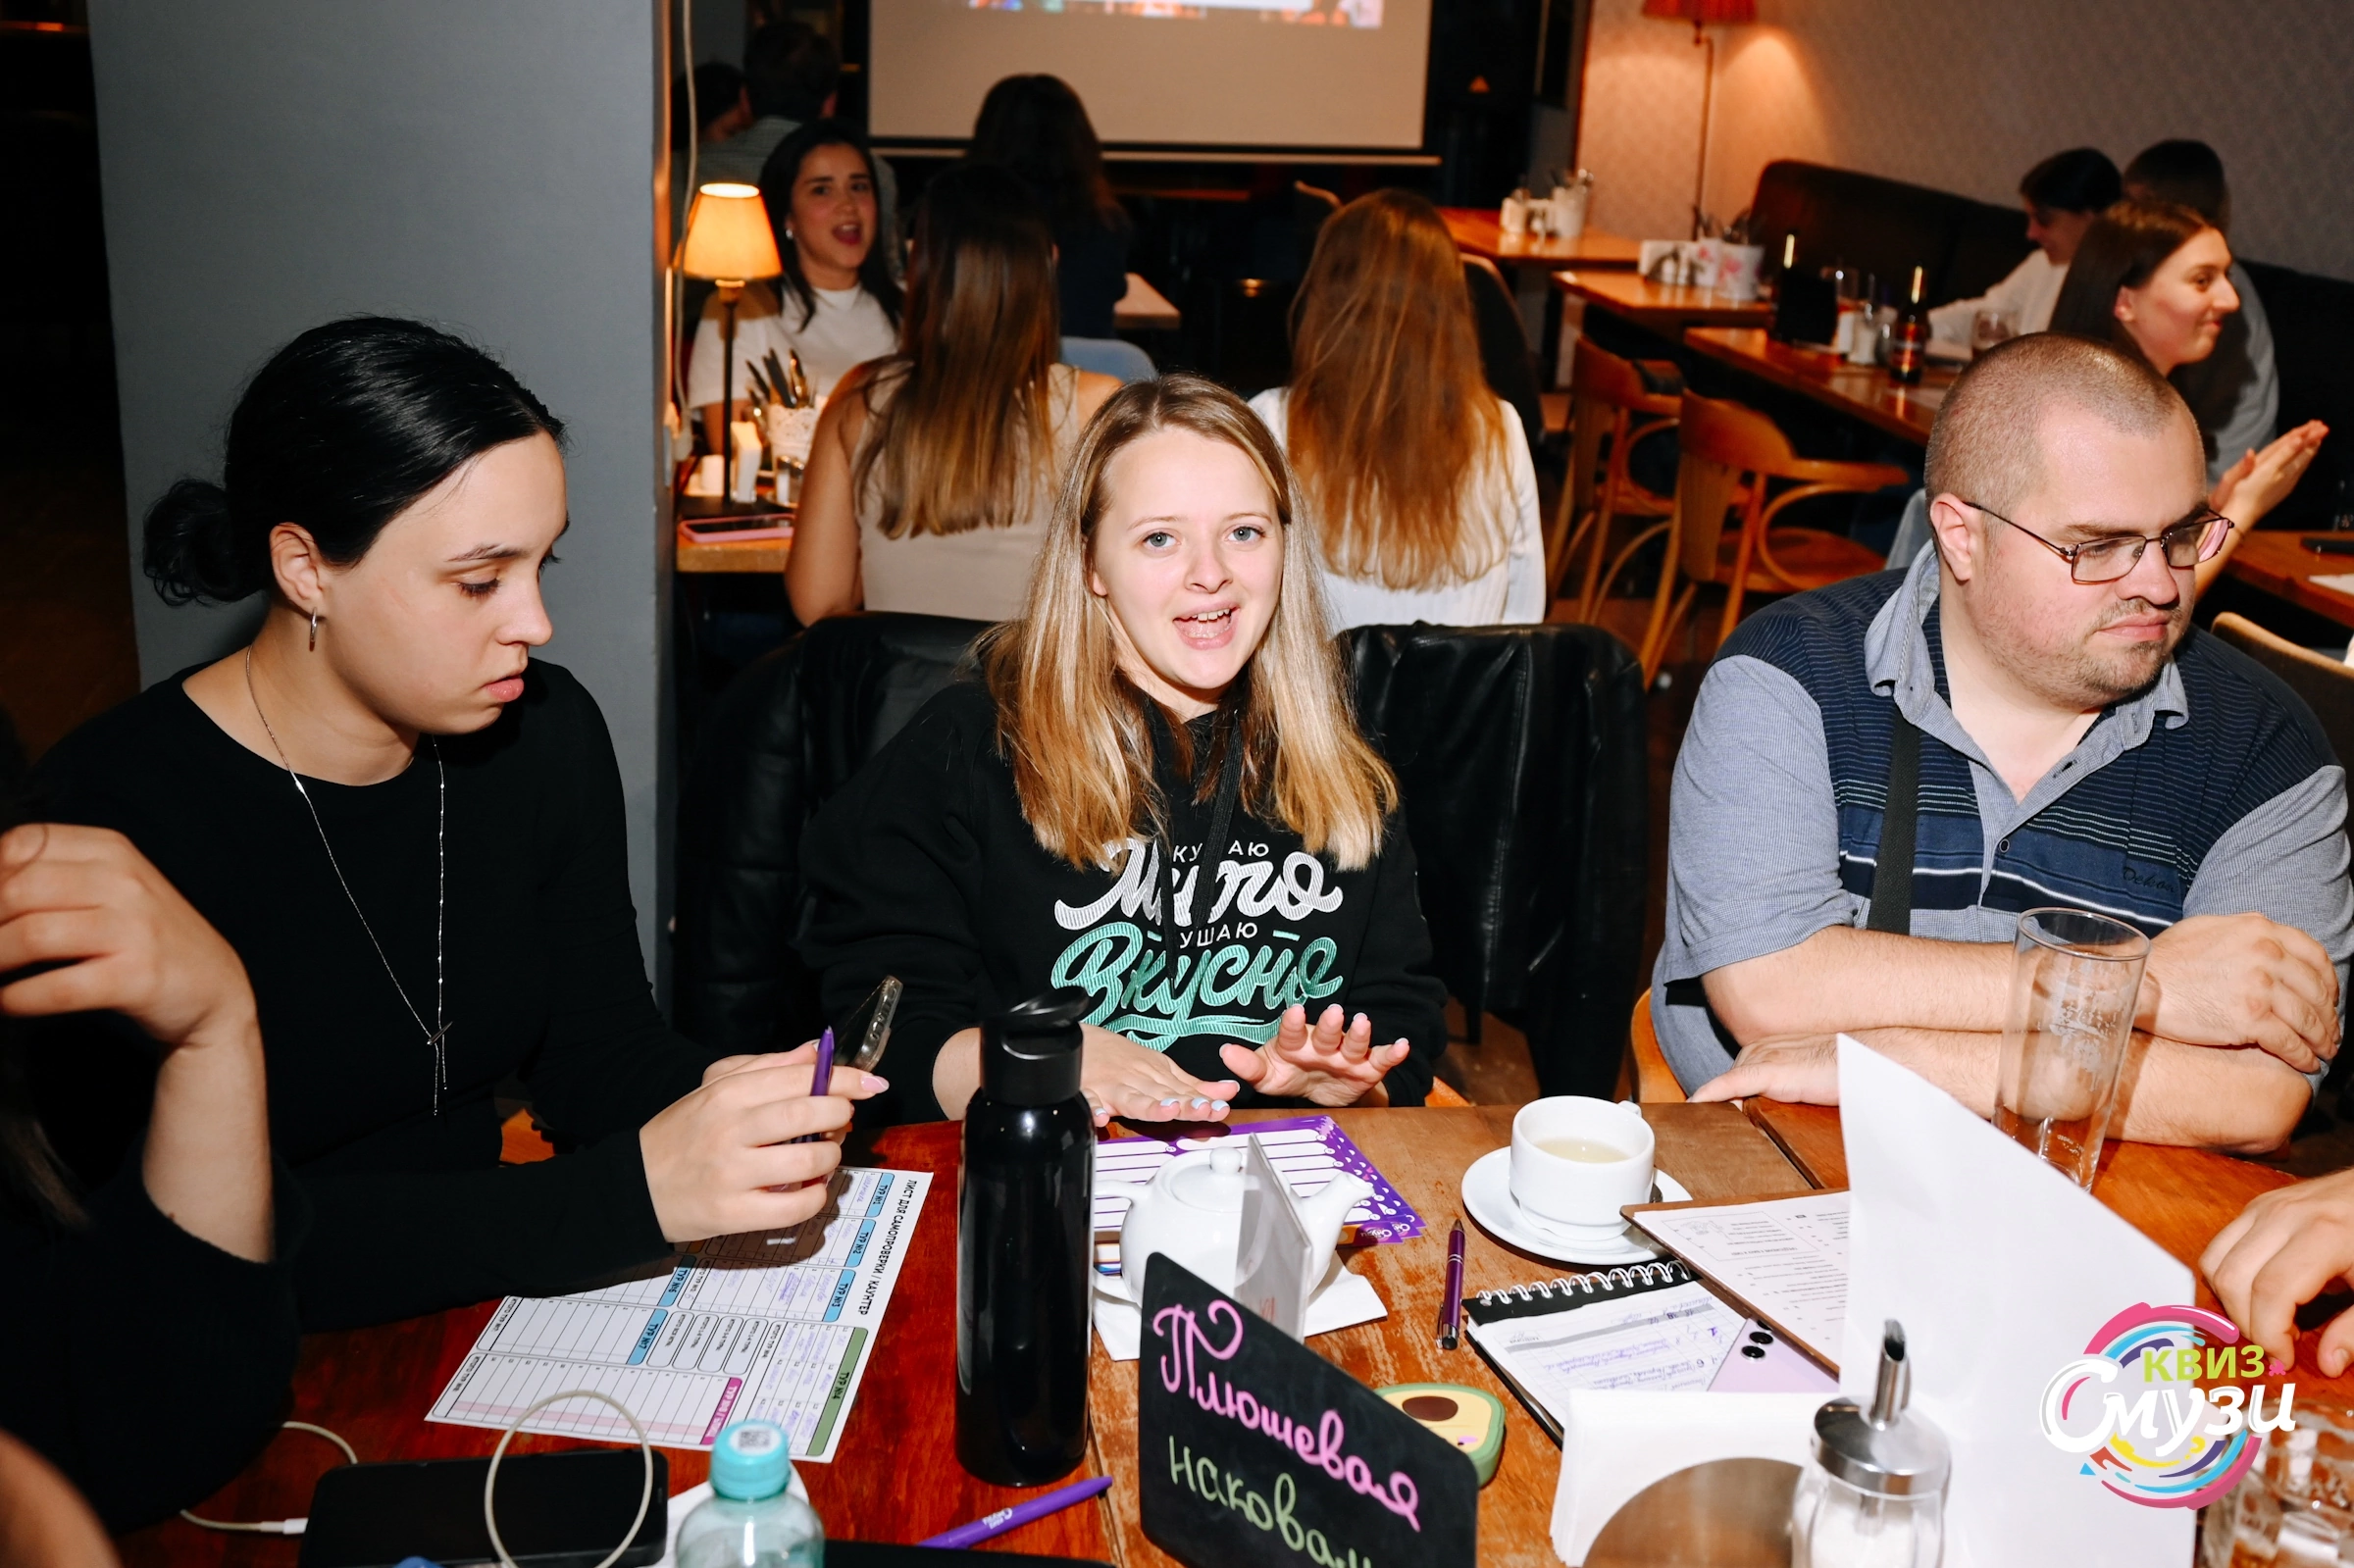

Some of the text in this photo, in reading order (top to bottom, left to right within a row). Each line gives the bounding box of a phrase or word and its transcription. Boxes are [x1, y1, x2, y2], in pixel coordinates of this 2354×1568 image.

[1173, 839, 1269, 863] КУАЮ
[1180, 923, 1257, 949] УШАЮ
[872, 1184, 888, 1205] ТУР №1
[901, 1179, 917, 1198] ЛИСТ
[895, 1198, 909, 1213] ДЛЯ
[852, 1231, 868, 1254] ТУР №2
[872, 1214, 903, 1274] САМОПРОВЕРКИ
[675, 1268, 688, 1281] ТУР
[831, 1282, 848, 1307] ТУР №3
[856, 1280, 879, 1315] КАУНТЕР
[638, 1322, 658, 1348] ТУР №7
[831, 1371, 849, 1399] ТУР №4
[1152, 1299, 1420, 1532] Плюшевая
